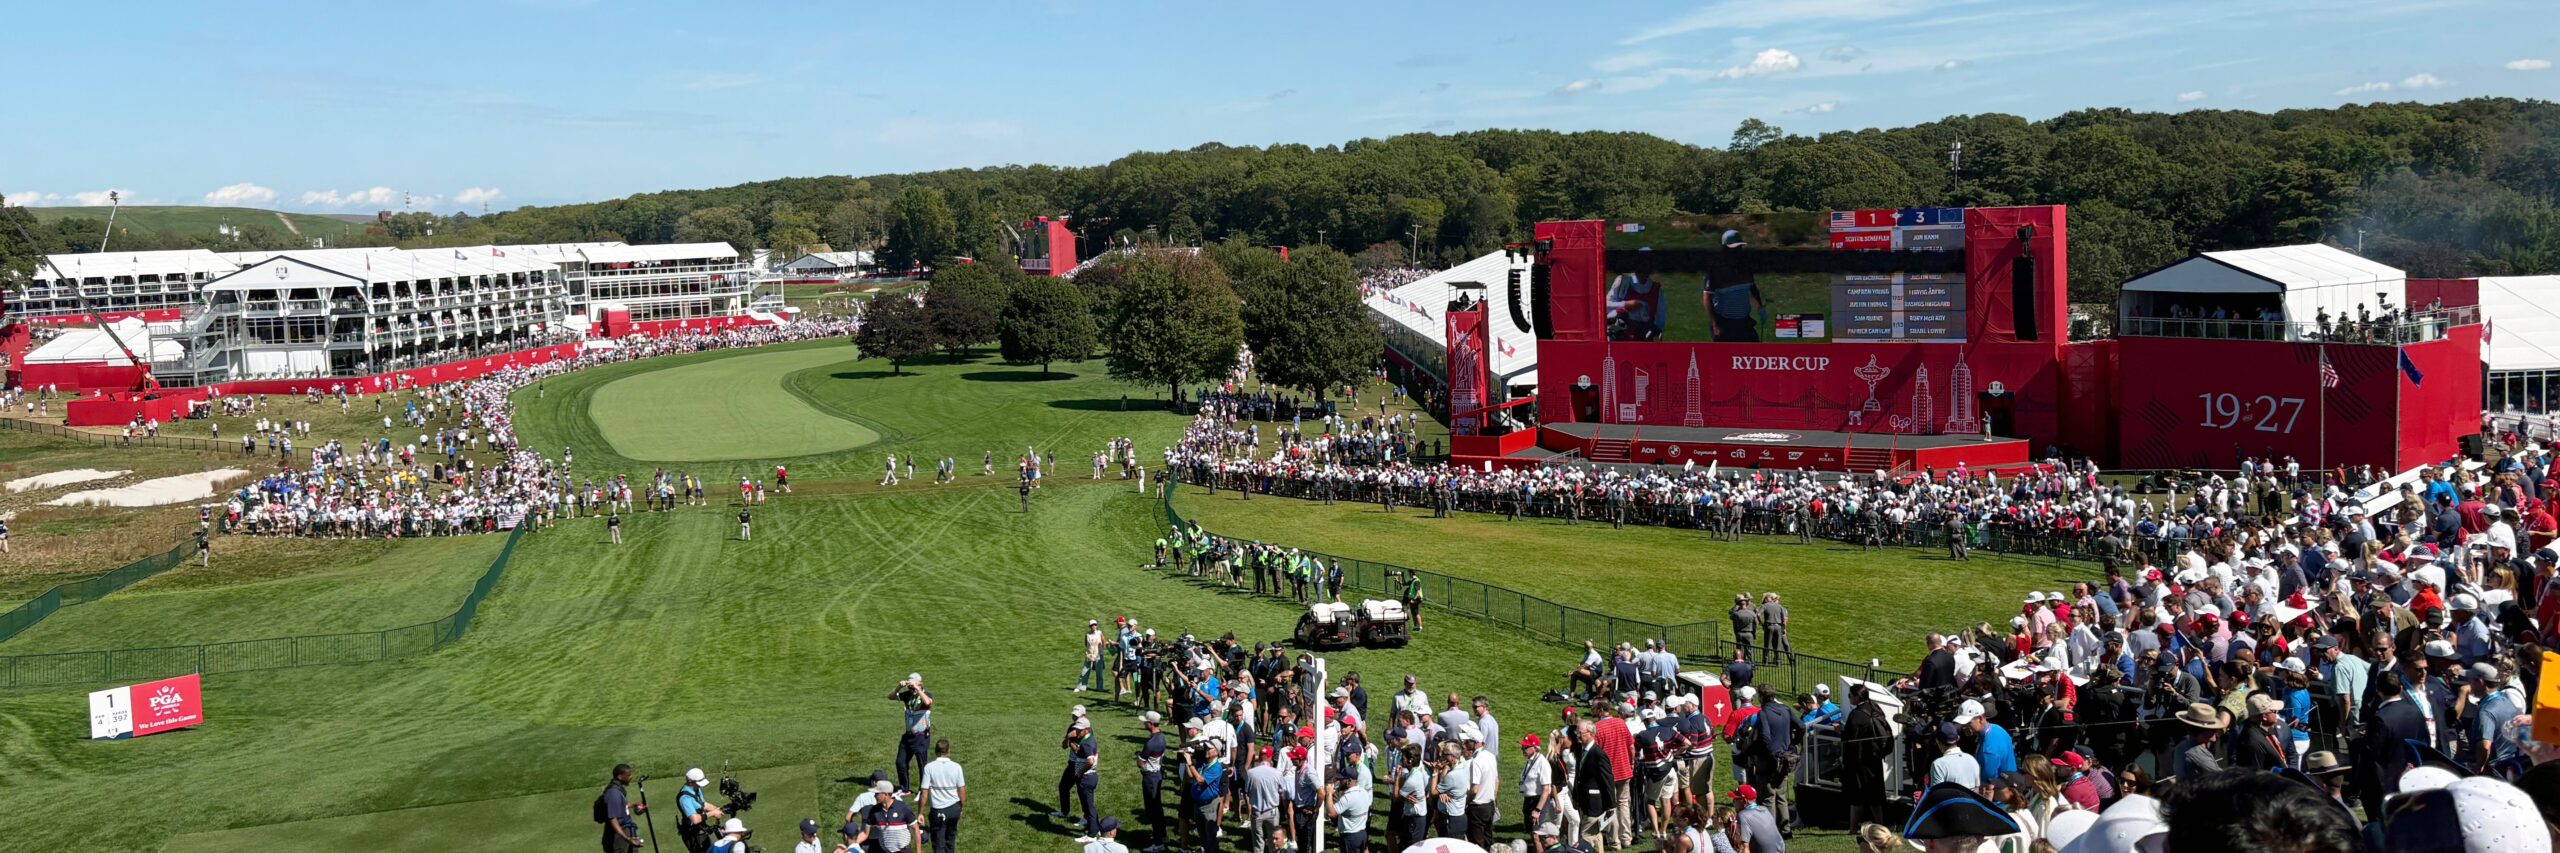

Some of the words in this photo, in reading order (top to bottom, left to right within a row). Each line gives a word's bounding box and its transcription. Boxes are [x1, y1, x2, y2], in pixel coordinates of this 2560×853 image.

[1869, 212, 1877, 225] 1
[1915, 211, 1925, 223] 3
[1731, 356, 1790, 370] RYDER
[1792, 356, 1830, 371] CUP
[1730, 448, 1746, 458] citi
[106, 693, 114, 708] 1
[149, 693, 183, 707] PGA
[112, 714, 128, 723] 397
[165, 717, 178, 725] this
[178, 714, 197, 722] Game
